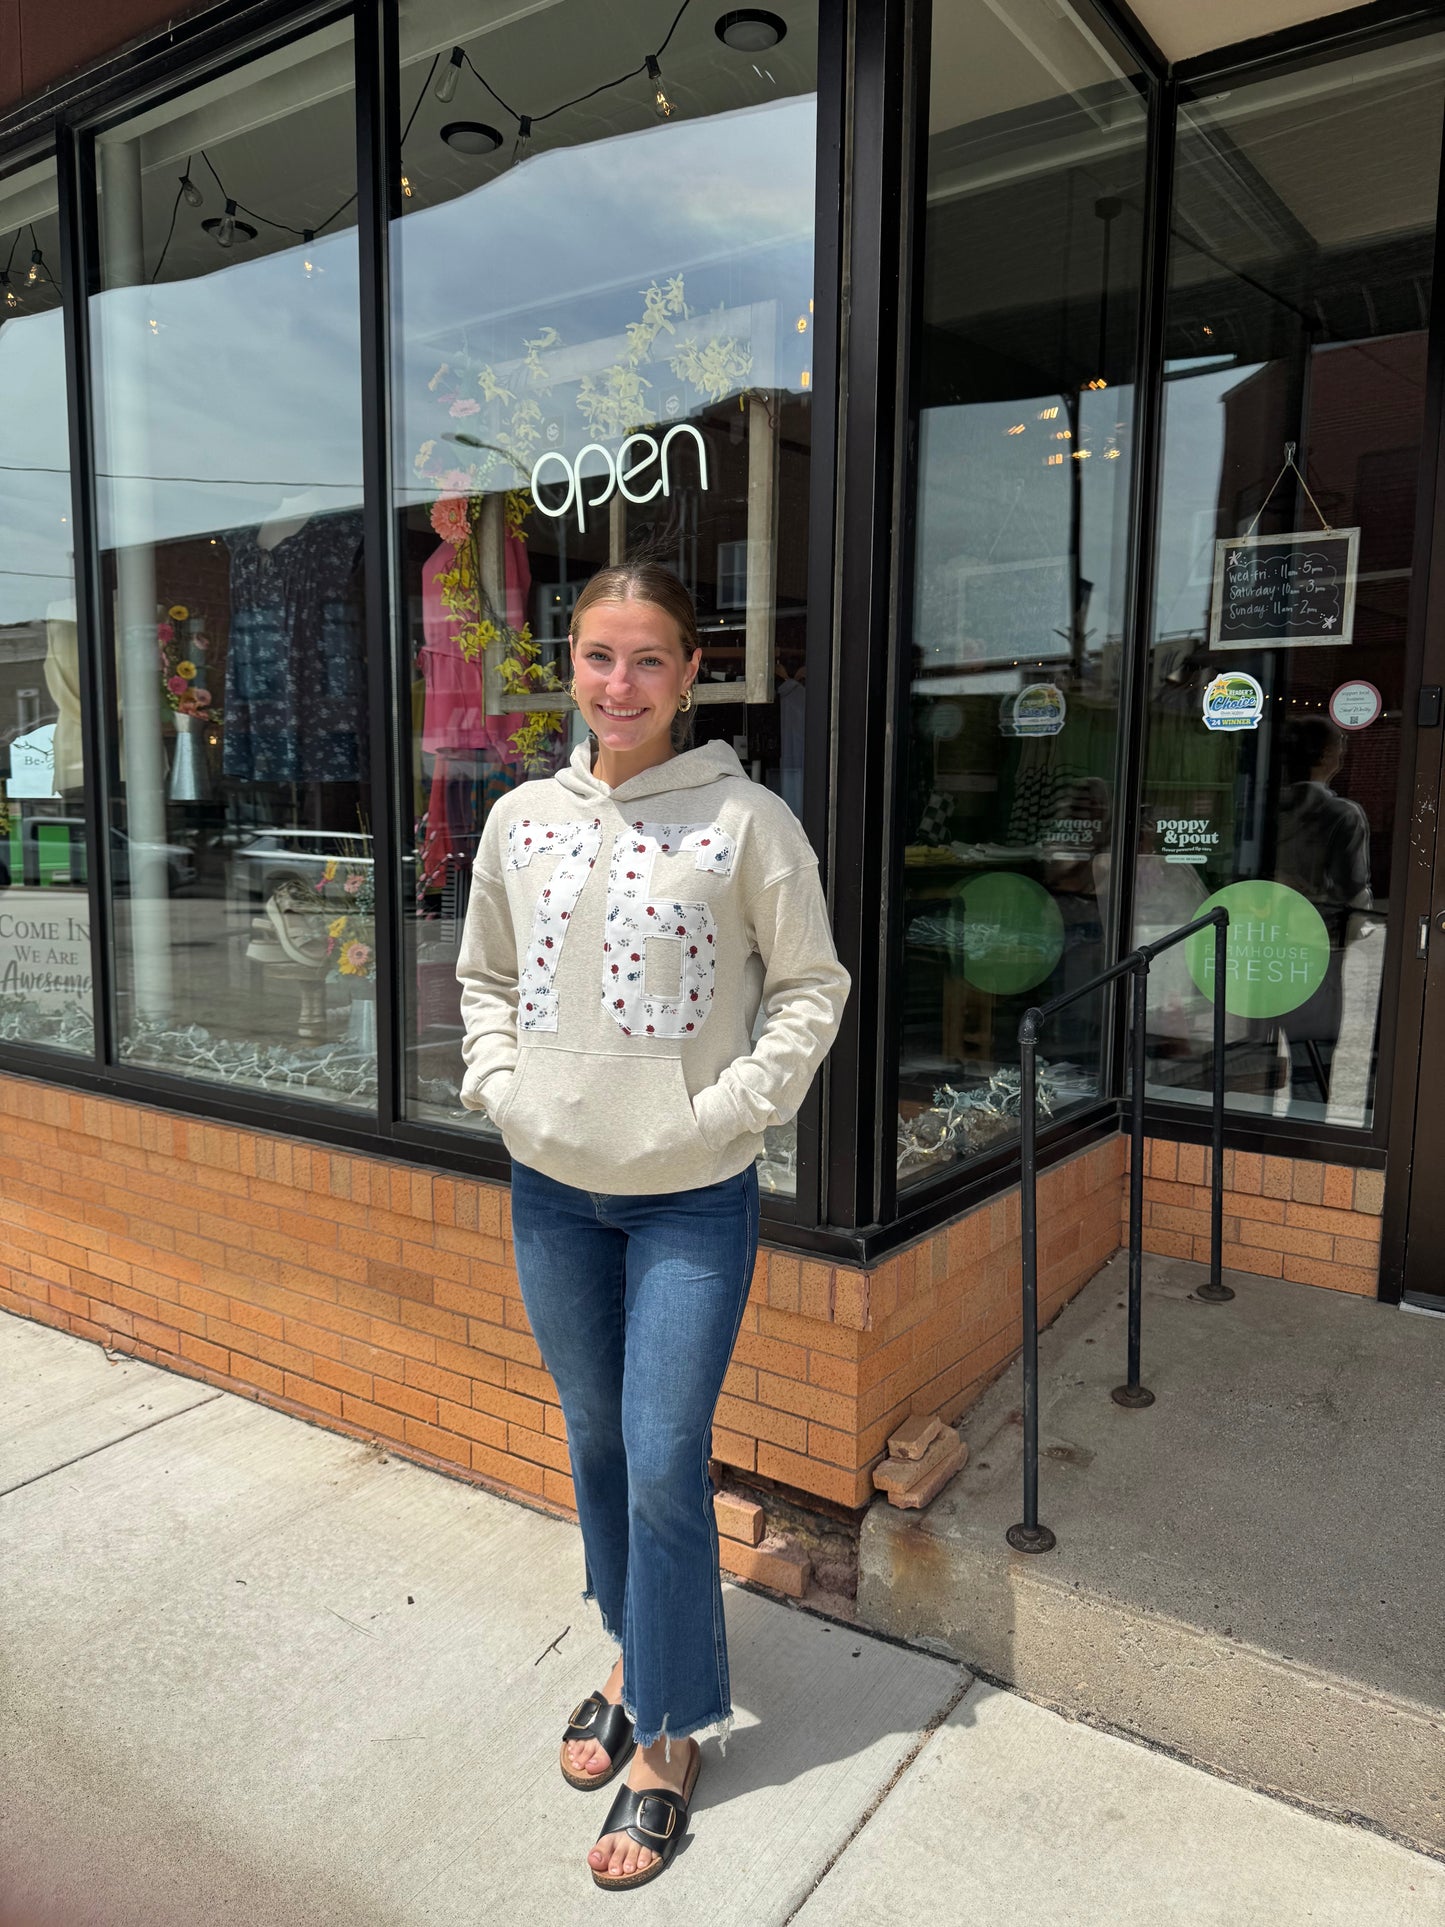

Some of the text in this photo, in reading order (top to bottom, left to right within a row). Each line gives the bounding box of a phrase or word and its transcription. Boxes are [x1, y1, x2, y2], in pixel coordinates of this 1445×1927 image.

[531, 424, 708, 534] open
[1211, 695, 1256, 711] Choice
[1222, 718, 1251, 726] WINNER
[1156, 819, 1210, 834] poppy
[507, 818, 737, 1038] 76
[46, 947, 80, 966] ARE
[1204, 943, 1310, 960] FRMHOUSE
[0, 959, 93, 999] Awesome
